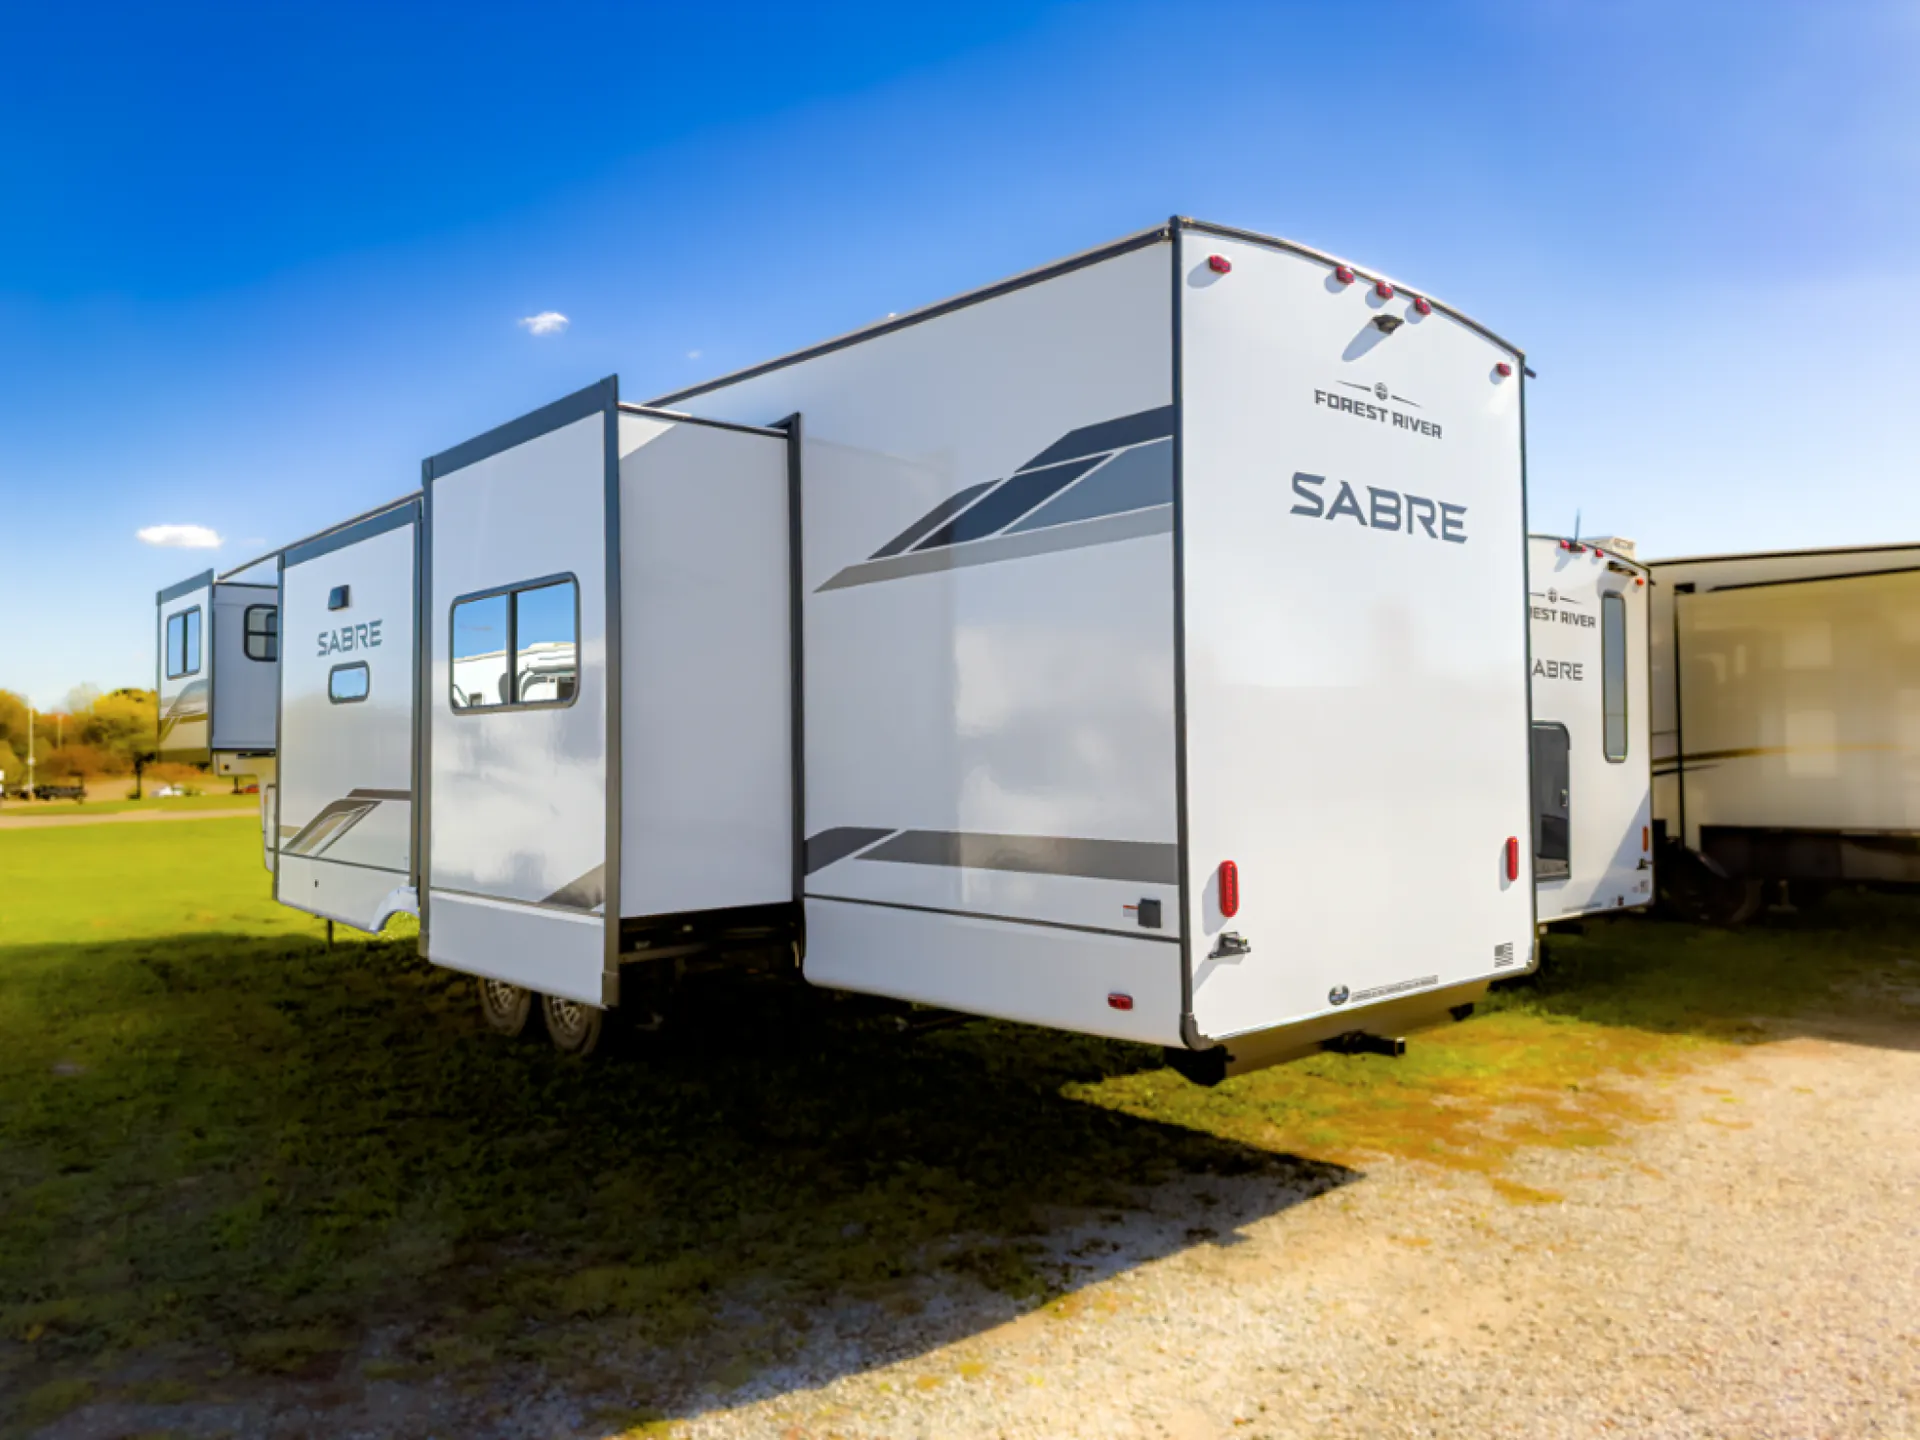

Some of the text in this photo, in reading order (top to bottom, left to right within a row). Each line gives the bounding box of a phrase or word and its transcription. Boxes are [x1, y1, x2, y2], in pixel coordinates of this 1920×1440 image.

[1313, 388, 1442, 439] FOREST RIVER
[1289, 471, 1468, 544] SABRE
[1529, 605, 1596, 628] EST RIVER
[317, 619, 383, 656] SABRE
[1530, 658, 1584, 680] ABRE
